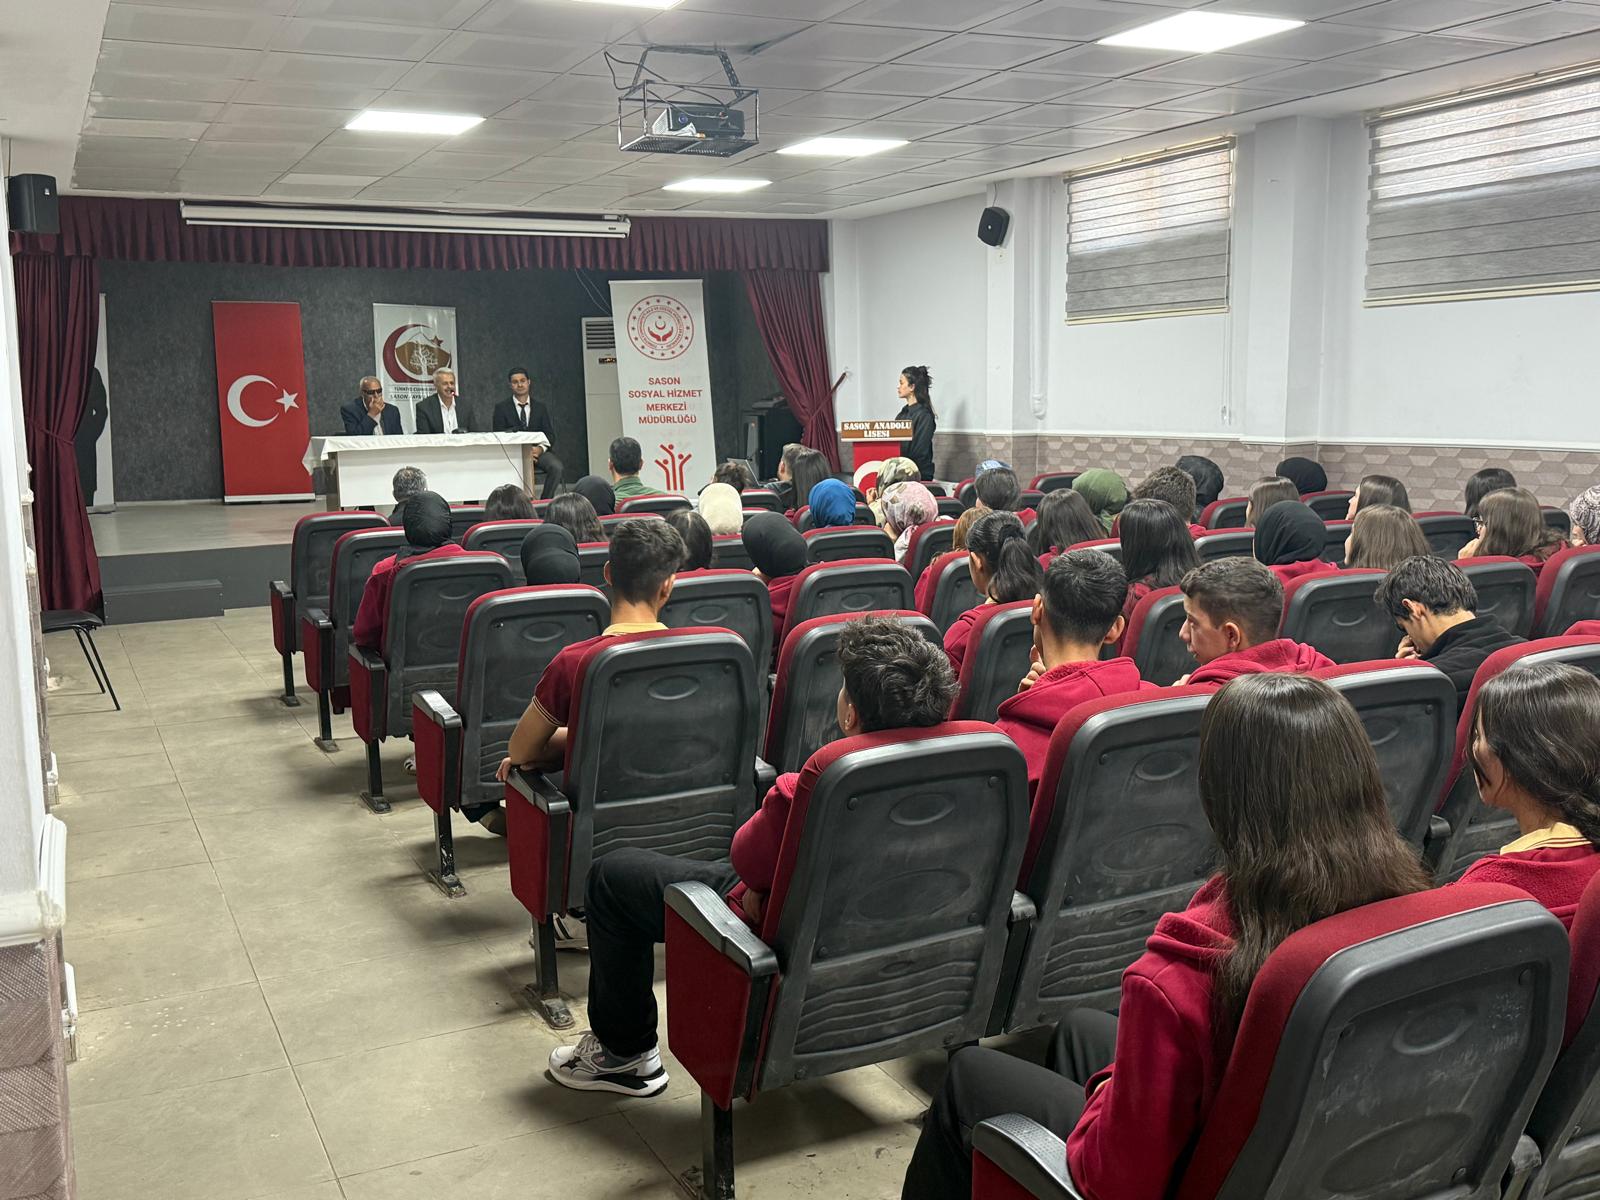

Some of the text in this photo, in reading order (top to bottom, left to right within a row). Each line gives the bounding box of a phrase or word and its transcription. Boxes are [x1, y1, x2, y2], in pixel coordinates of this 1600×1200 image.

[648, 377, 681, 385] SASON
[628, 388, 703, 398] SOSYAL HİZMET
[646, 401, 687, 411] MERKEZİ
[638, 414, 697, 424] MÜDÜRLÜĞÜ
[843, 421, 912, 430] SASON ANADOLU
